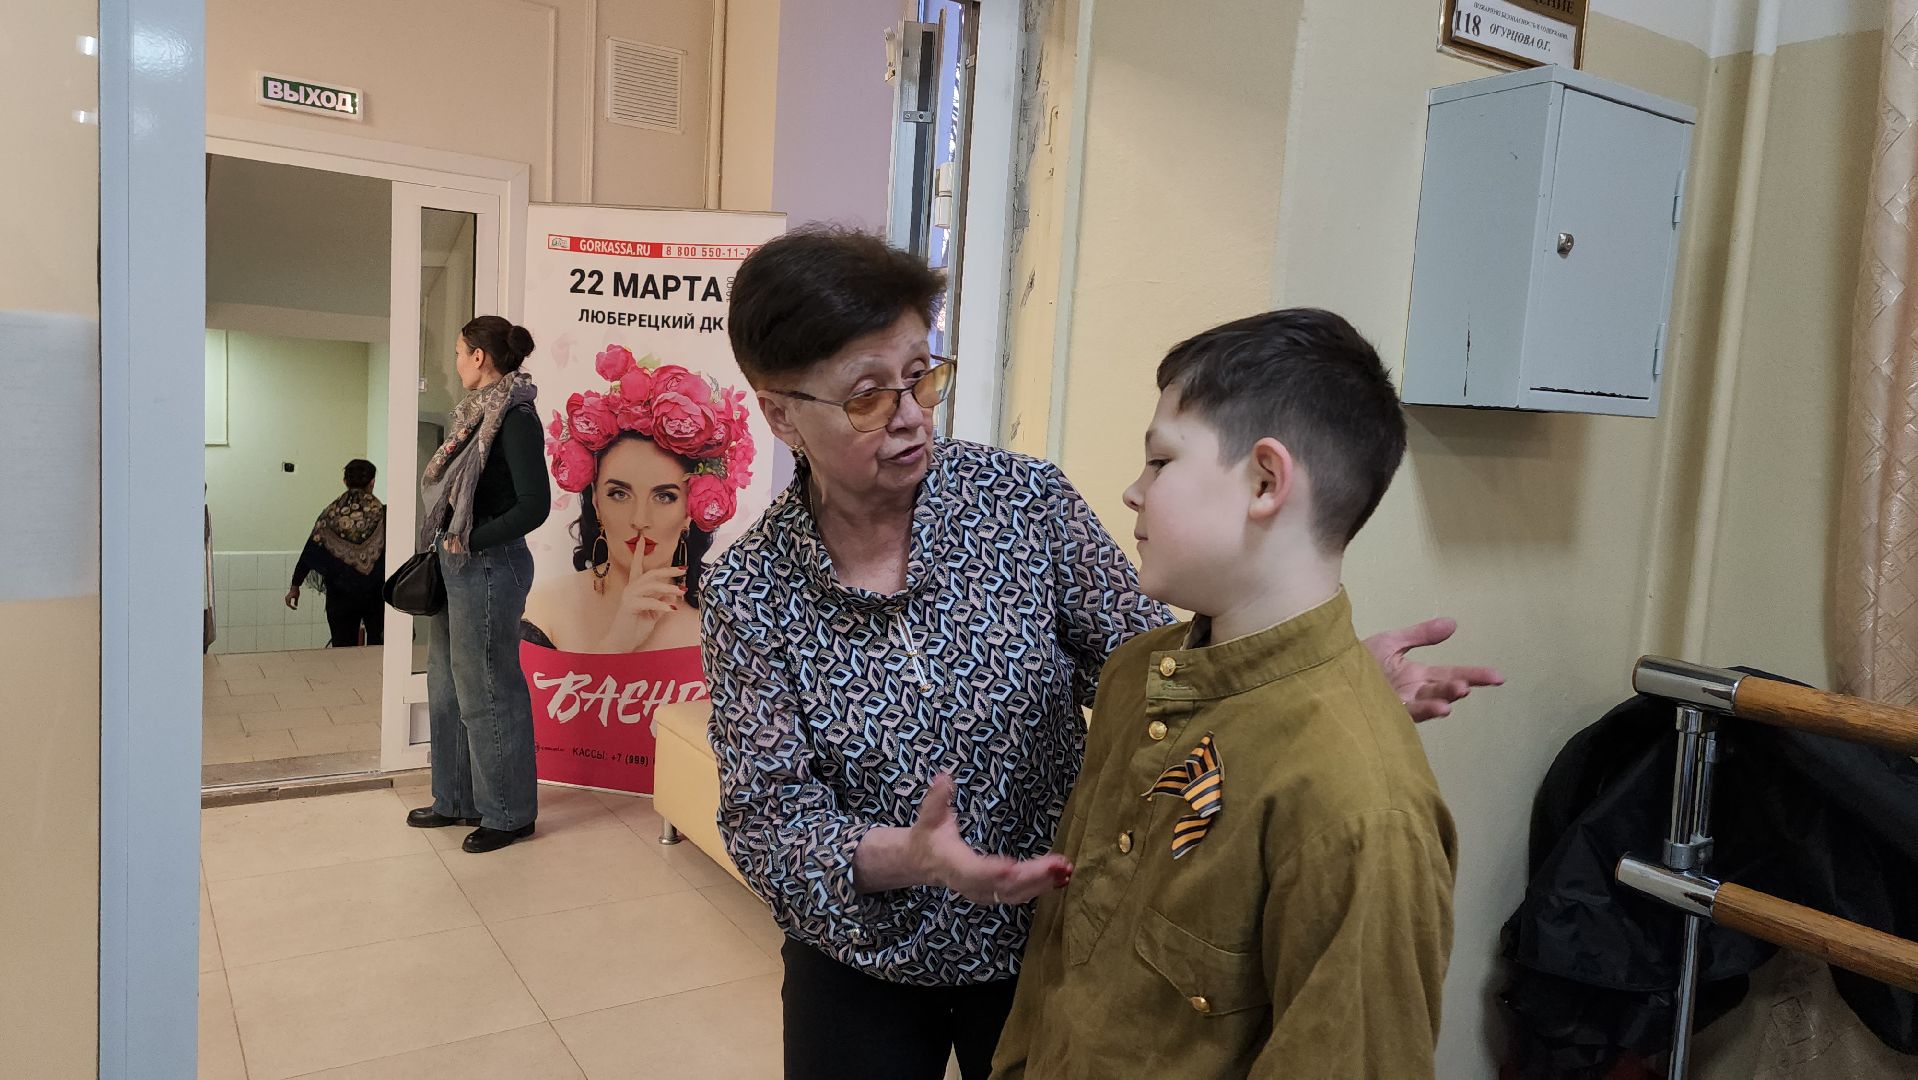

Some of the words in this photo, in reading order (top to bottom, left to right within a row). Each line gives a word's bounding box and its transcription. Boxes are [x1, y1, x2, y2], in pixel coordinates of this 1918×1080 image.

[1456, 10, 1482, 37] 118
[1489, 23, 1535, 47] ОГУРЦОВА
[267, 80, 353, 113] ВЫХОД
[579, 239, 651, 257] GORKASSA.RU
[666, 246, 672, 256] 8
[677, 246, 697, 257] 800
[701, 247, 751, 258] 550-11-7
[569, 268, 604, 295] 22
[613, 271, 723, 302] МАРТА
[578, 308, 695, 331] ЛЮБЕРЕЦКИЙ
[699, 316, 724, 333] ДК
[573, 747, 608, 760] КАССЫ:
[611, 753, 622, 761] +7
